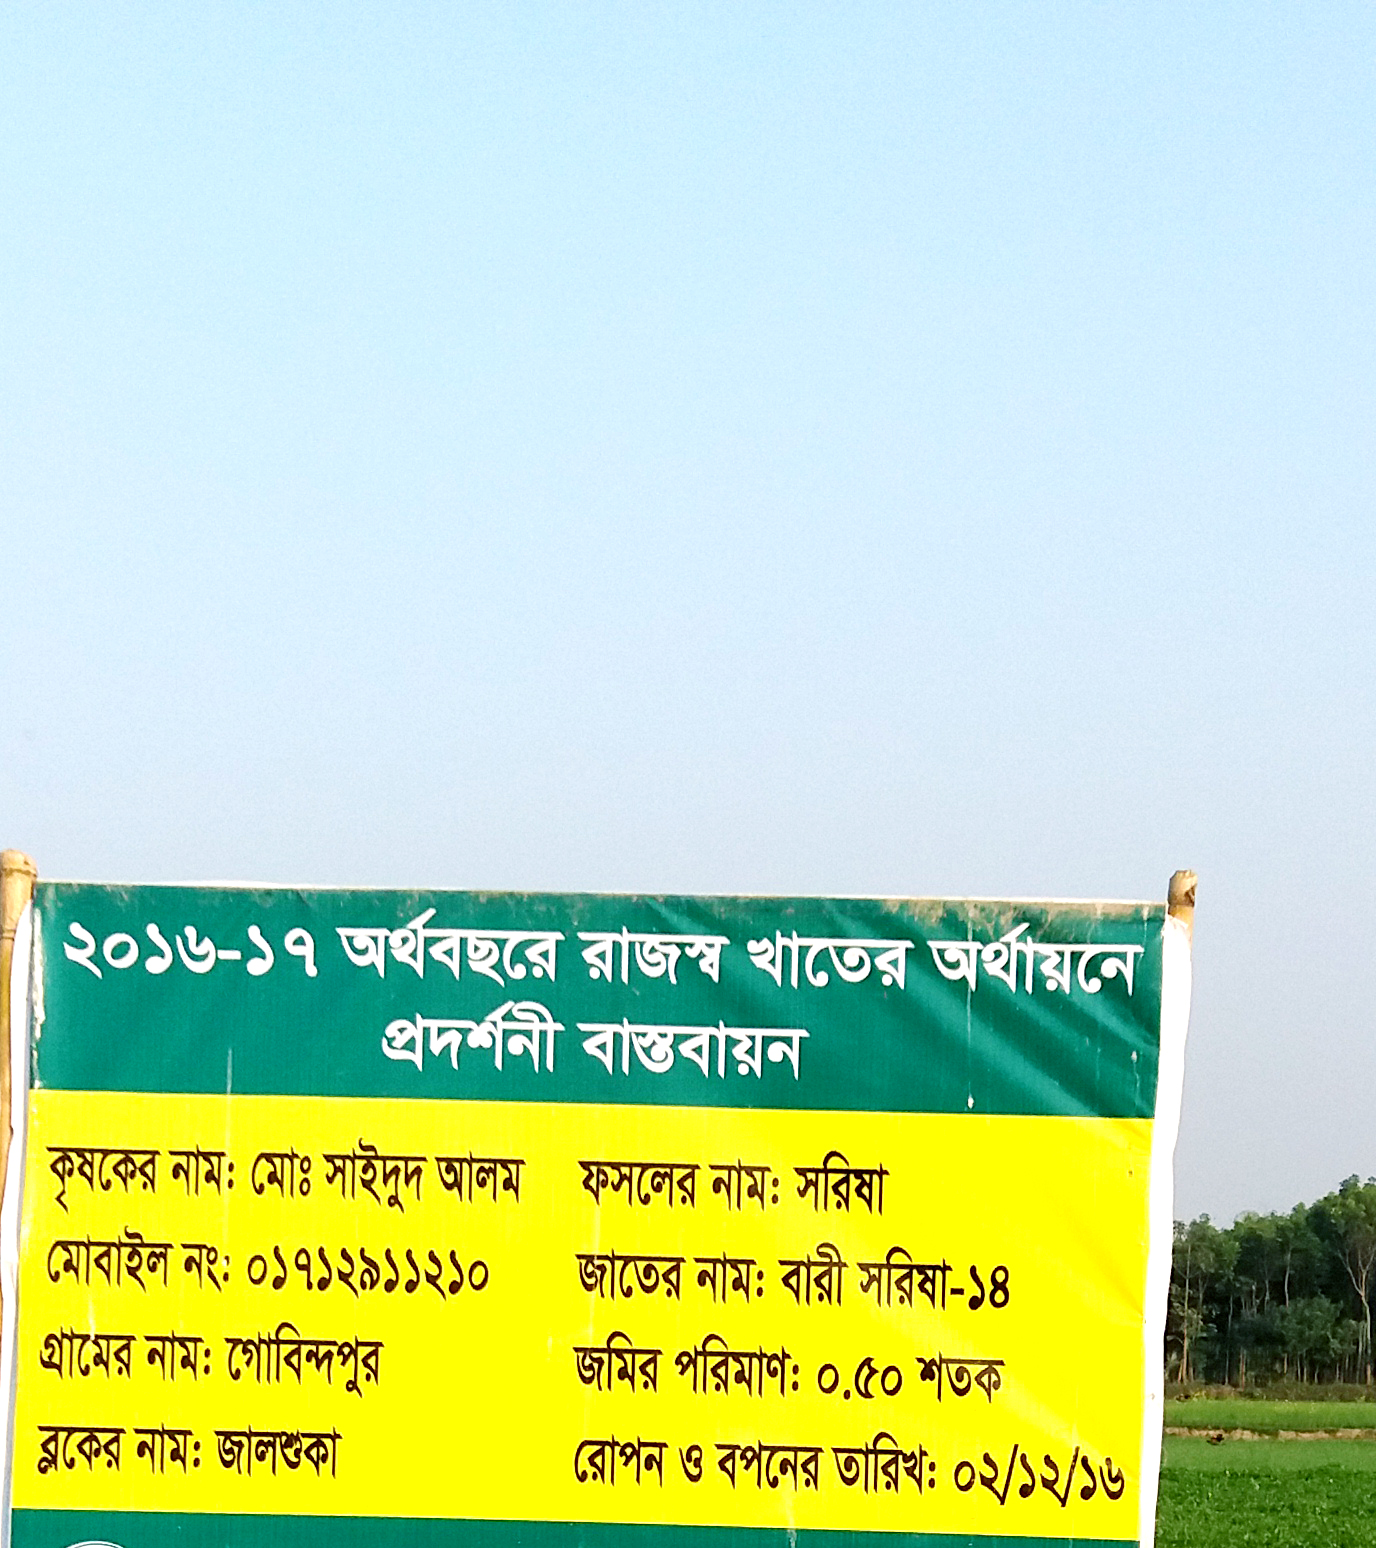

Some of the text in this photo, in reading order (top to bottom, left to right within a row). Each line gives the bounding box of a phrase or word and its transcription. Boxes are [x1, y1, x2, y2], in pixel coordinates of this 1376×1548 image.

[63, 907, 1145, 996] ২০১৬-১৭ অর্থবছরে রাজস্ব খাতের অর্থায়নে
[381, 1000, 810, 1080] প্রদর্শনী বাস্তবায়ন
[46, 1146, 161, 1212] কৃষকের
[168, 1145, 235, 1196] নাম:
[322, 1137, 428, 1213] সাইদুদ
[434, 1151, 526, 1203] আলম
[577, 1150, 890, 1215] ফসলের নাম: সরিষা
[47, 1225, 489, 1301] মোবাইল নং: ০১৭১২৯১১২১০
[575, 1242, 1010, 1311] জাতের নাম: বারী সরিষা-১৪
[39, 1321, 385, 1398] গ্রামের নাম: গোবিন্দপুর
[572, 1330, 1006, 1403] জমির পরিমাণ: ০.৫০ শতক
[37, 1423, 343, 1478] ব্লকের নাম: জালশুকা
[574, 1431, 1125, 1508] রোপন ও বপনের তারিখ: ০২/১২/১৬
